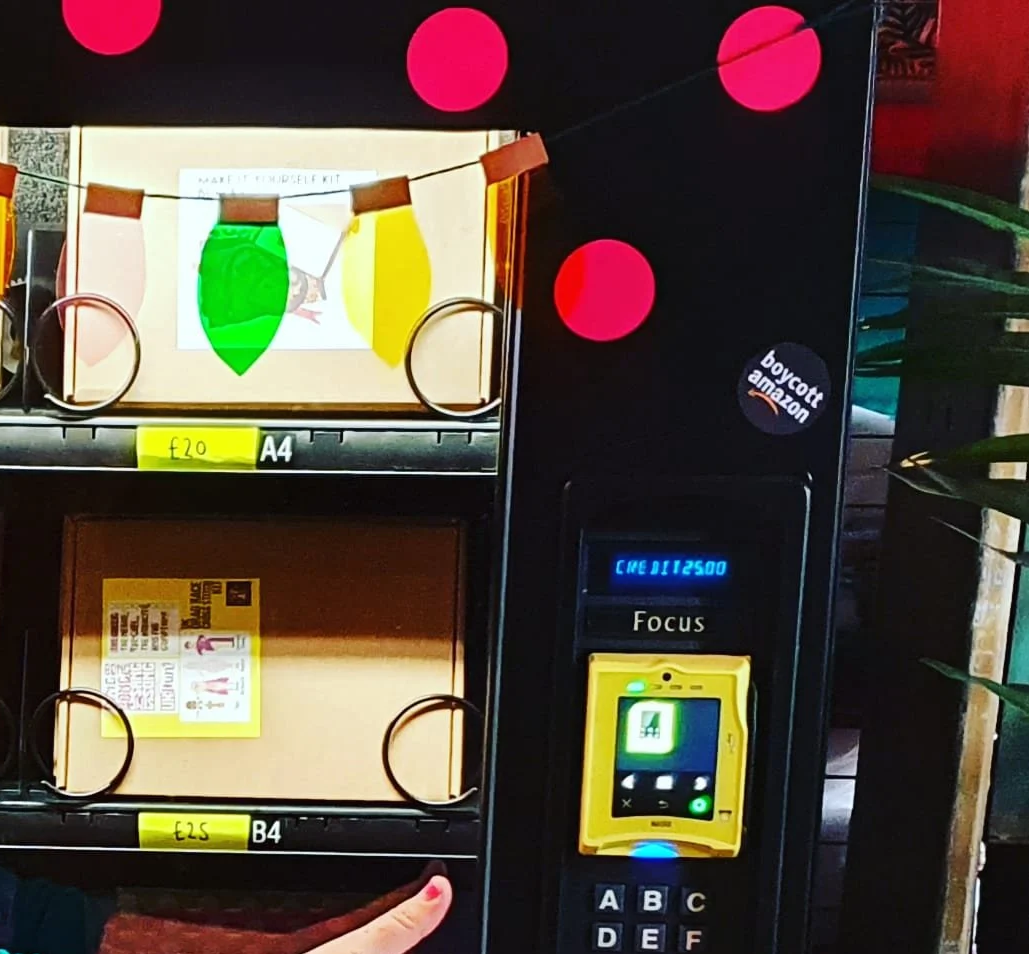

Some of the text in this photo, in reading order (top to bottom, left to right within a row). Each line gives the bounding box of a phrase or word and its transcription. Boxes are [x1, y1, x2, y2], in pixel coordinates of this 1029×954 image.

[323, 173, 341, 184] KIT
[760, 349, 824, 409] boycott
[747, 369, 810, 424] amazon
[168, 436, 207, 461] £20
[259, 434, 293, 463] A4
[632, 610, 705, 633] Focus
[252, 819, 282, 844] B4
[598, 889, 707, 912] A B C
[597, 927, 703, 951] D E F
